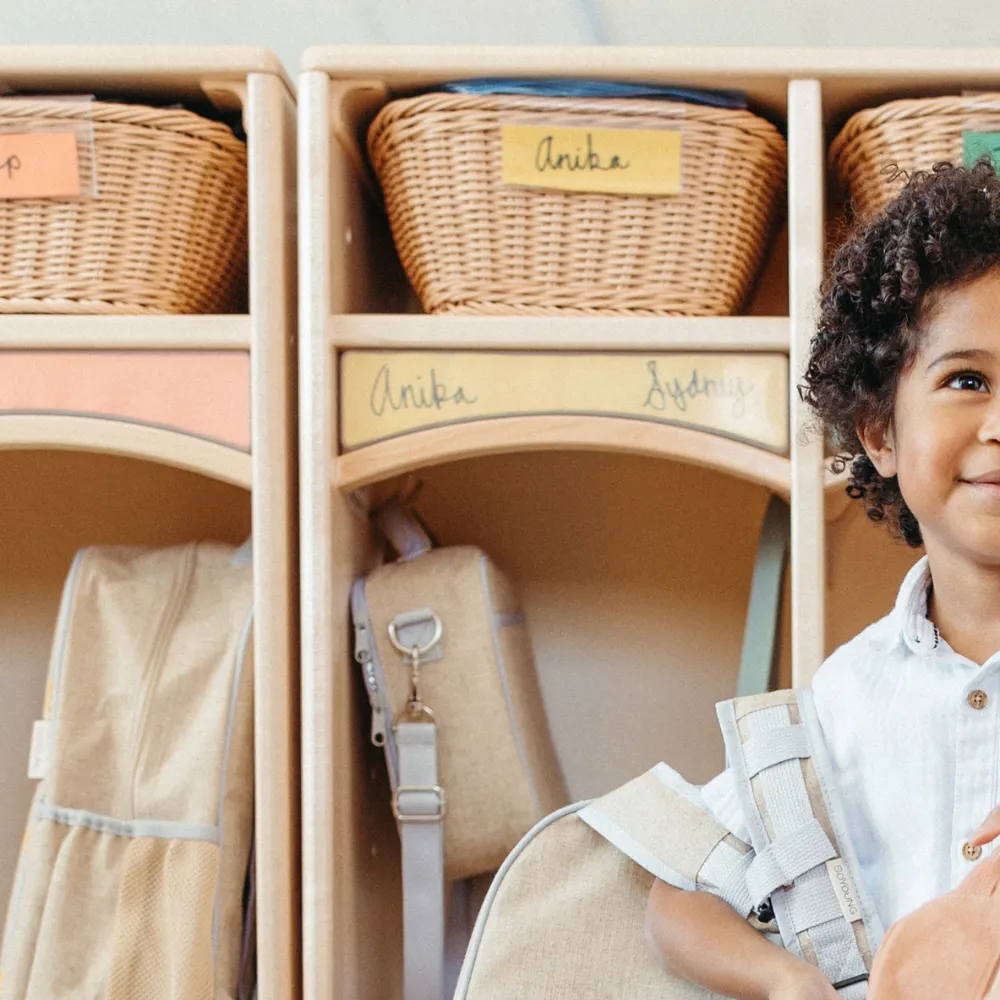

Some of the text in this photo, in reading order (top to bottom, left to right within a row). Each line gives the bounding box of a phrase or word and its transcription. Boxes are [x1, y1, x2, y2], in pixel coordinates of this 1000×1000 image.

[535, 133, 630, 172] Anika
[370, 363, 478, 417] Anika
[833, 864, 858, 915] SOYOUNG
